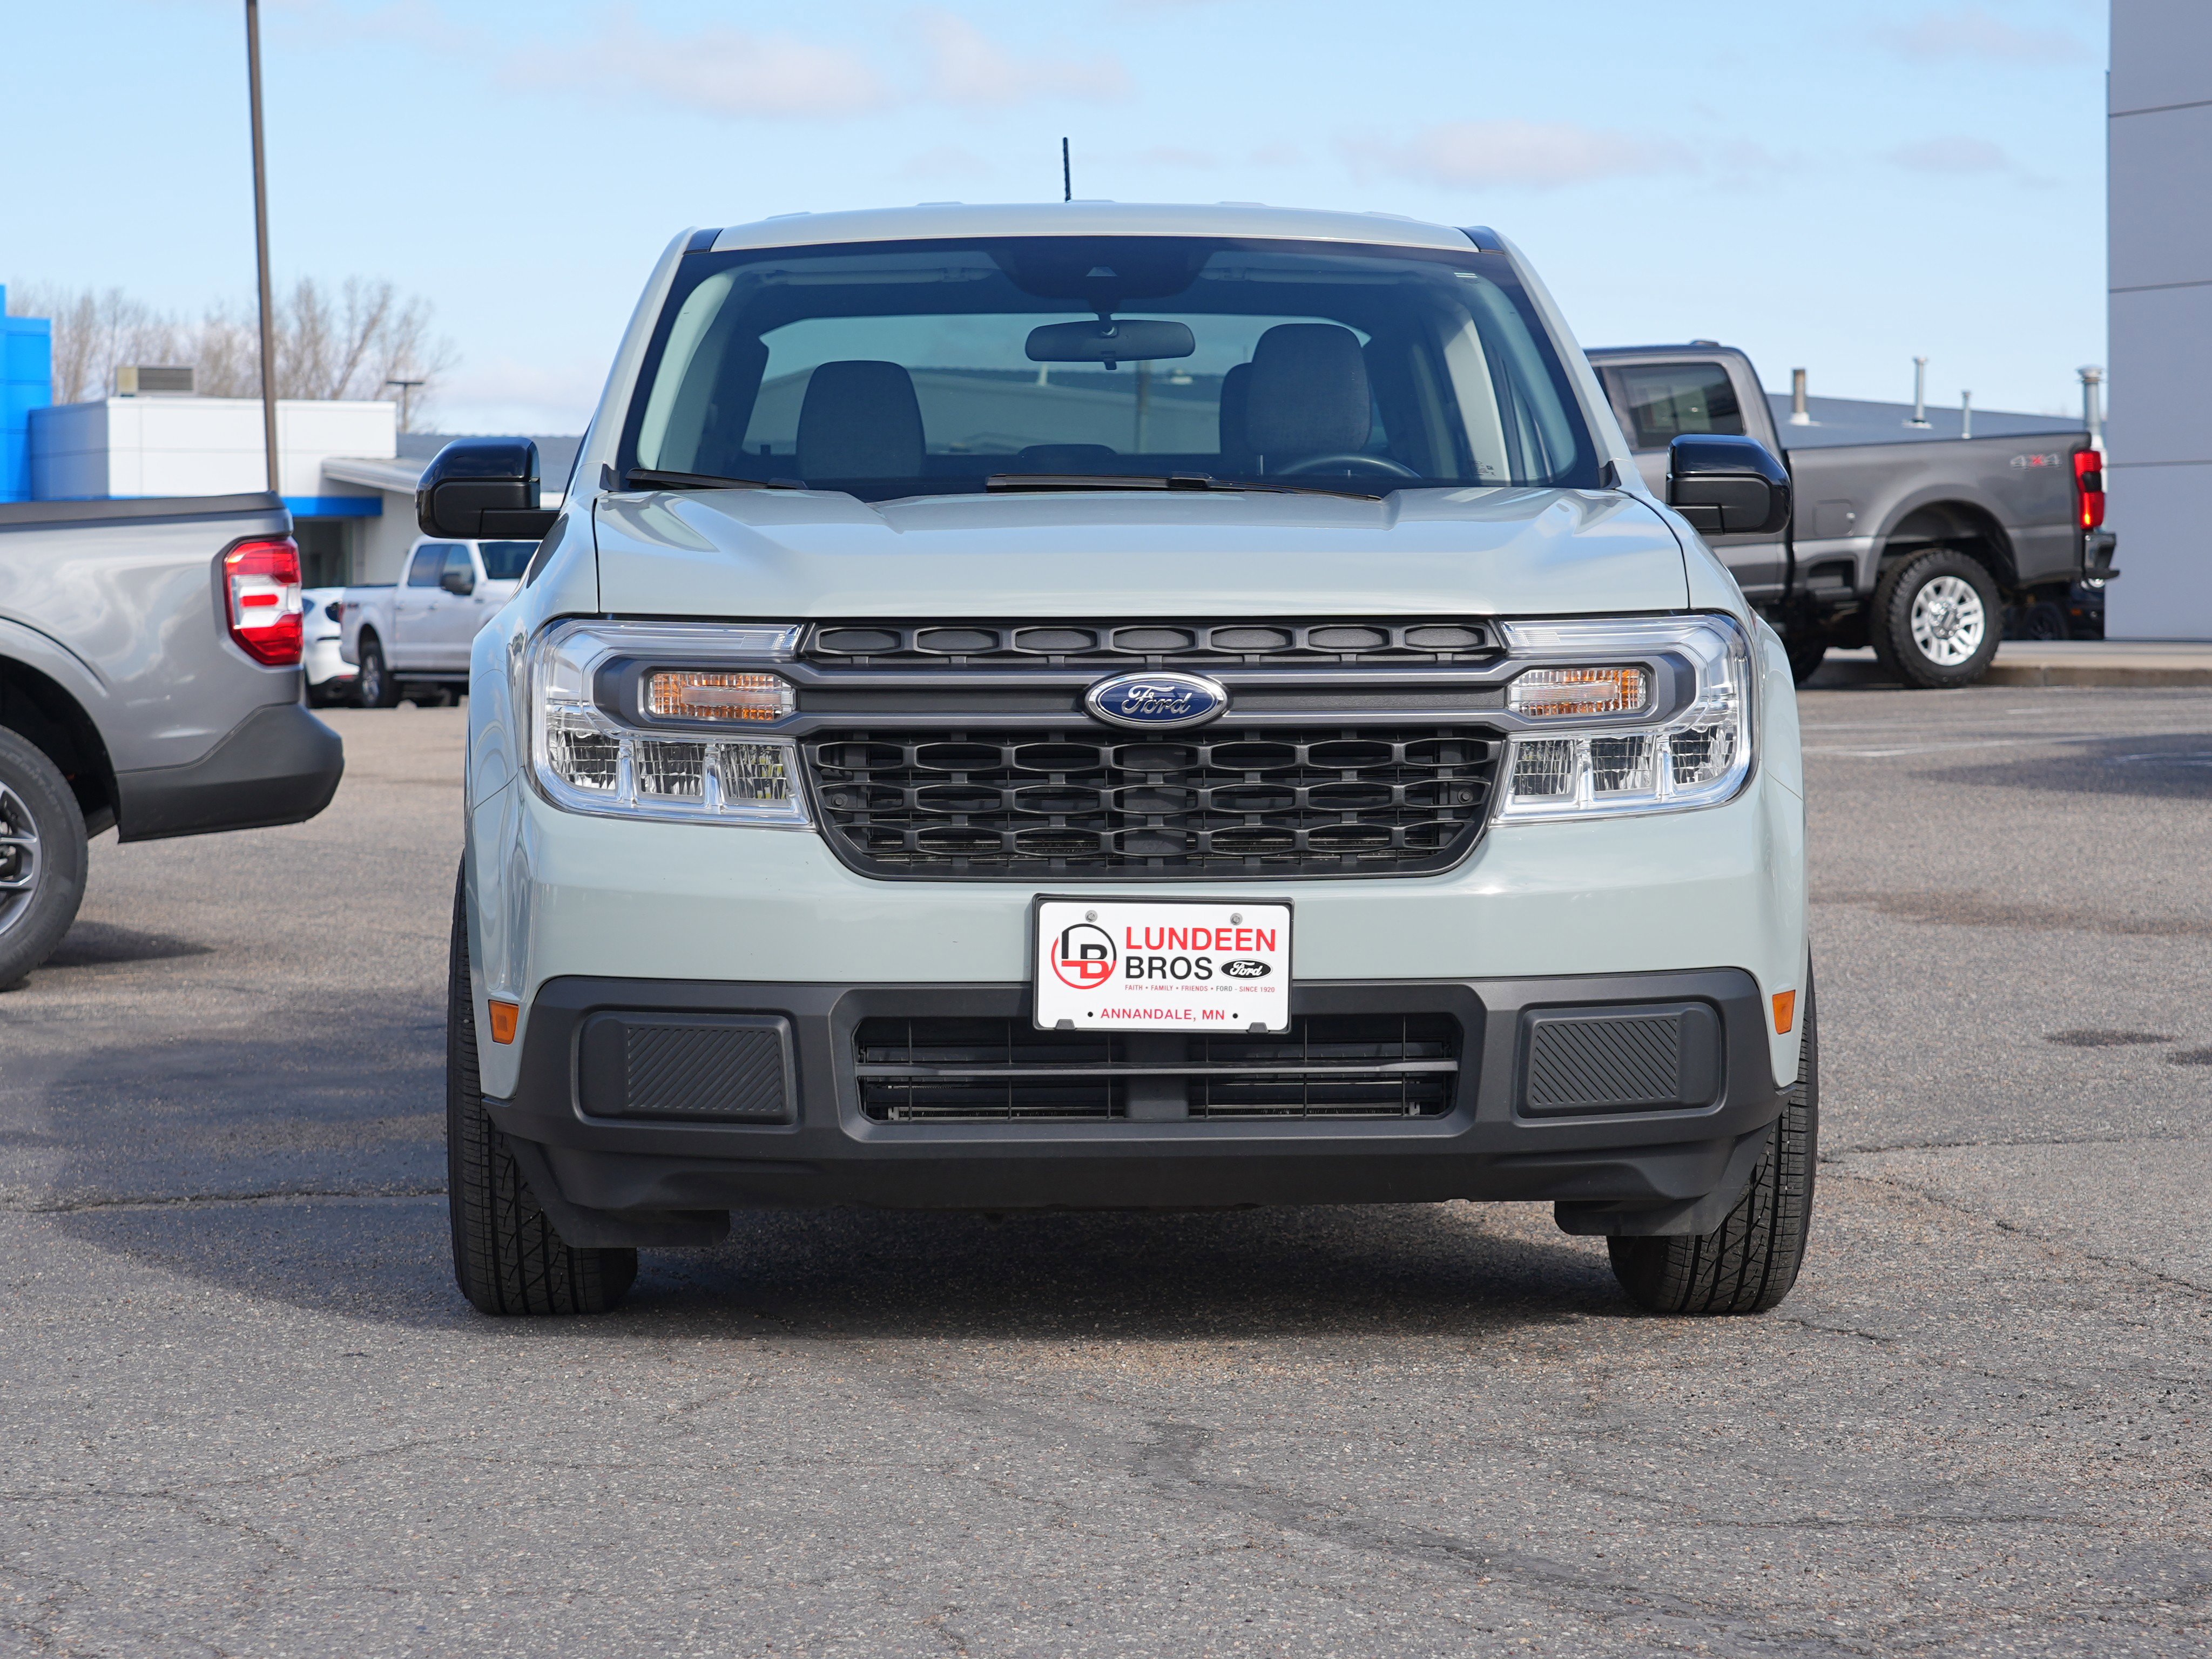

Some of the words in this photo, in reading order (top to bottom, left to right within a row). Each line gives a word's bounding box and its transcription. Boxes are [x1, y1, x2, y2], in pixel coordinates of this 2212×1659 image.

[1121, 685, 1192, 714] Ford
[1126, 927, 1276, 952] LUNDEEN
[1126, 956, 1213, 980] BROS
[1230, 961, 1263, 976] Ford
[1101, 1008, 1196, 1021] ANNANDALE,
[1202, 1009, 1225, 1020] MN
